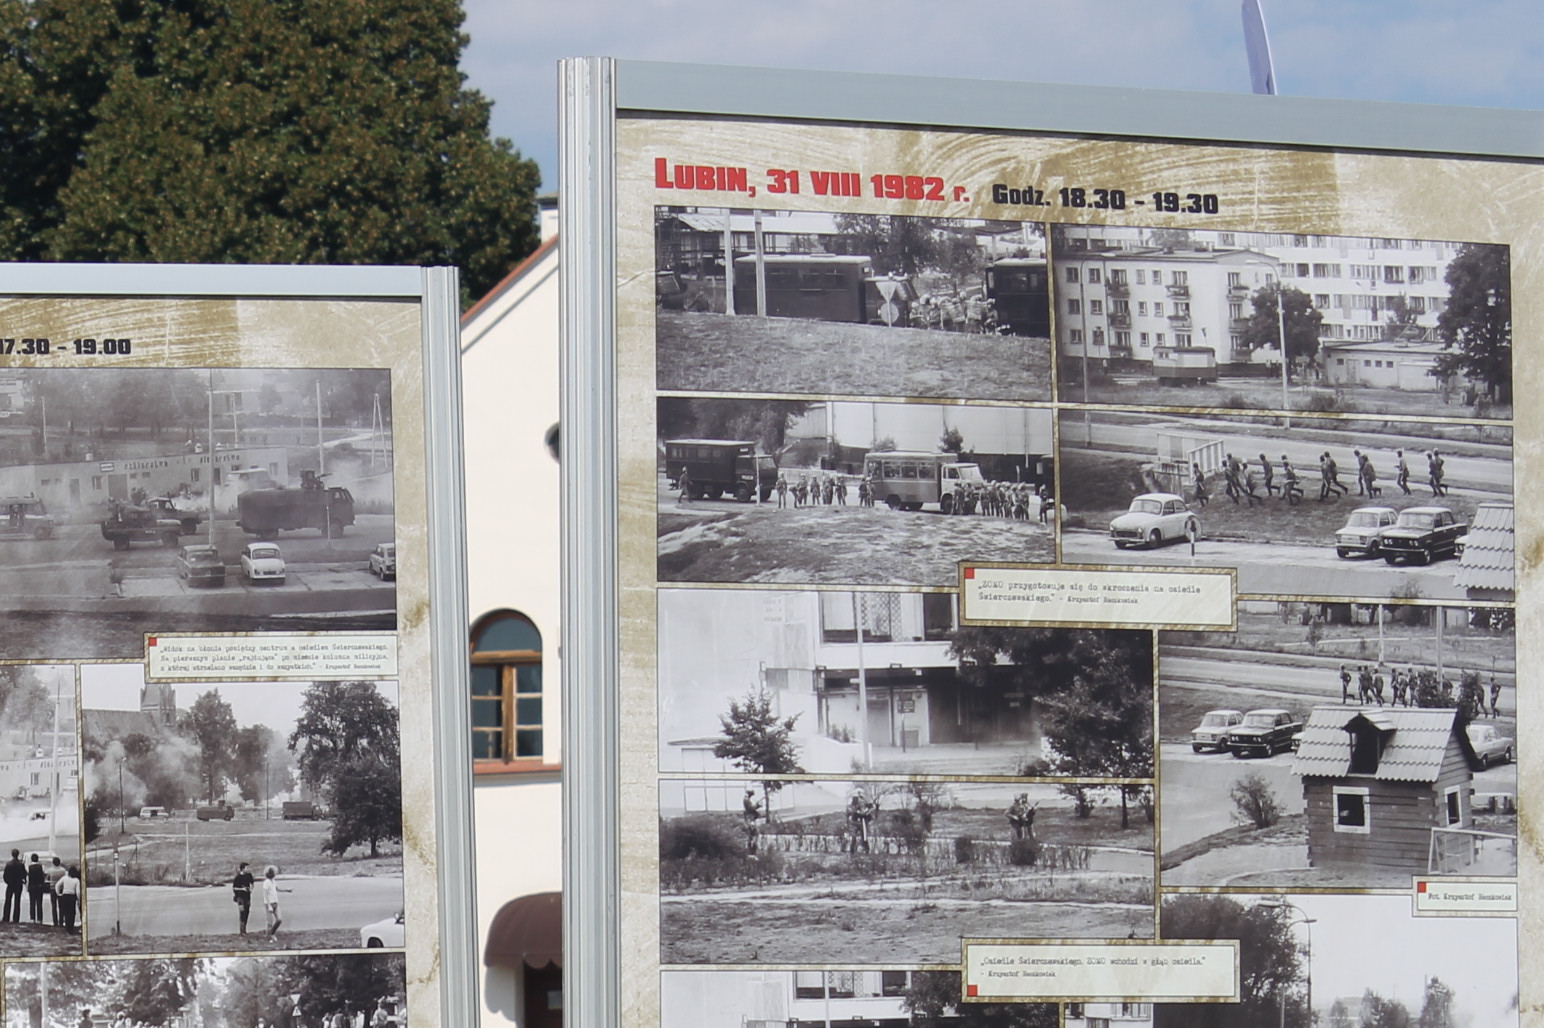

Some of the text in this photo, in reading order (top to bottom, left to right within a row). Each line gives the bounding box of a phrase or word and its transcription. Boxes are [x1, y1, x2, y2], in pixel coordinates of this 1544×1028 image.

[766, 169, 800, 194] 31
[810, 171, 861, 197] VIII
[870, 174, 945, 201] 1982
[954, 185, 969, 202] r.
[992, 184, 1051, 207] Godz.
[1059, 187, 1125, 210] 18.30
[1152, 192, 1219, 214] 19.30
[74, 338, 131, 354] 19.00
[1088, 583, 1098, 591] do
[1168, 585, 1201, 593] osiedle
